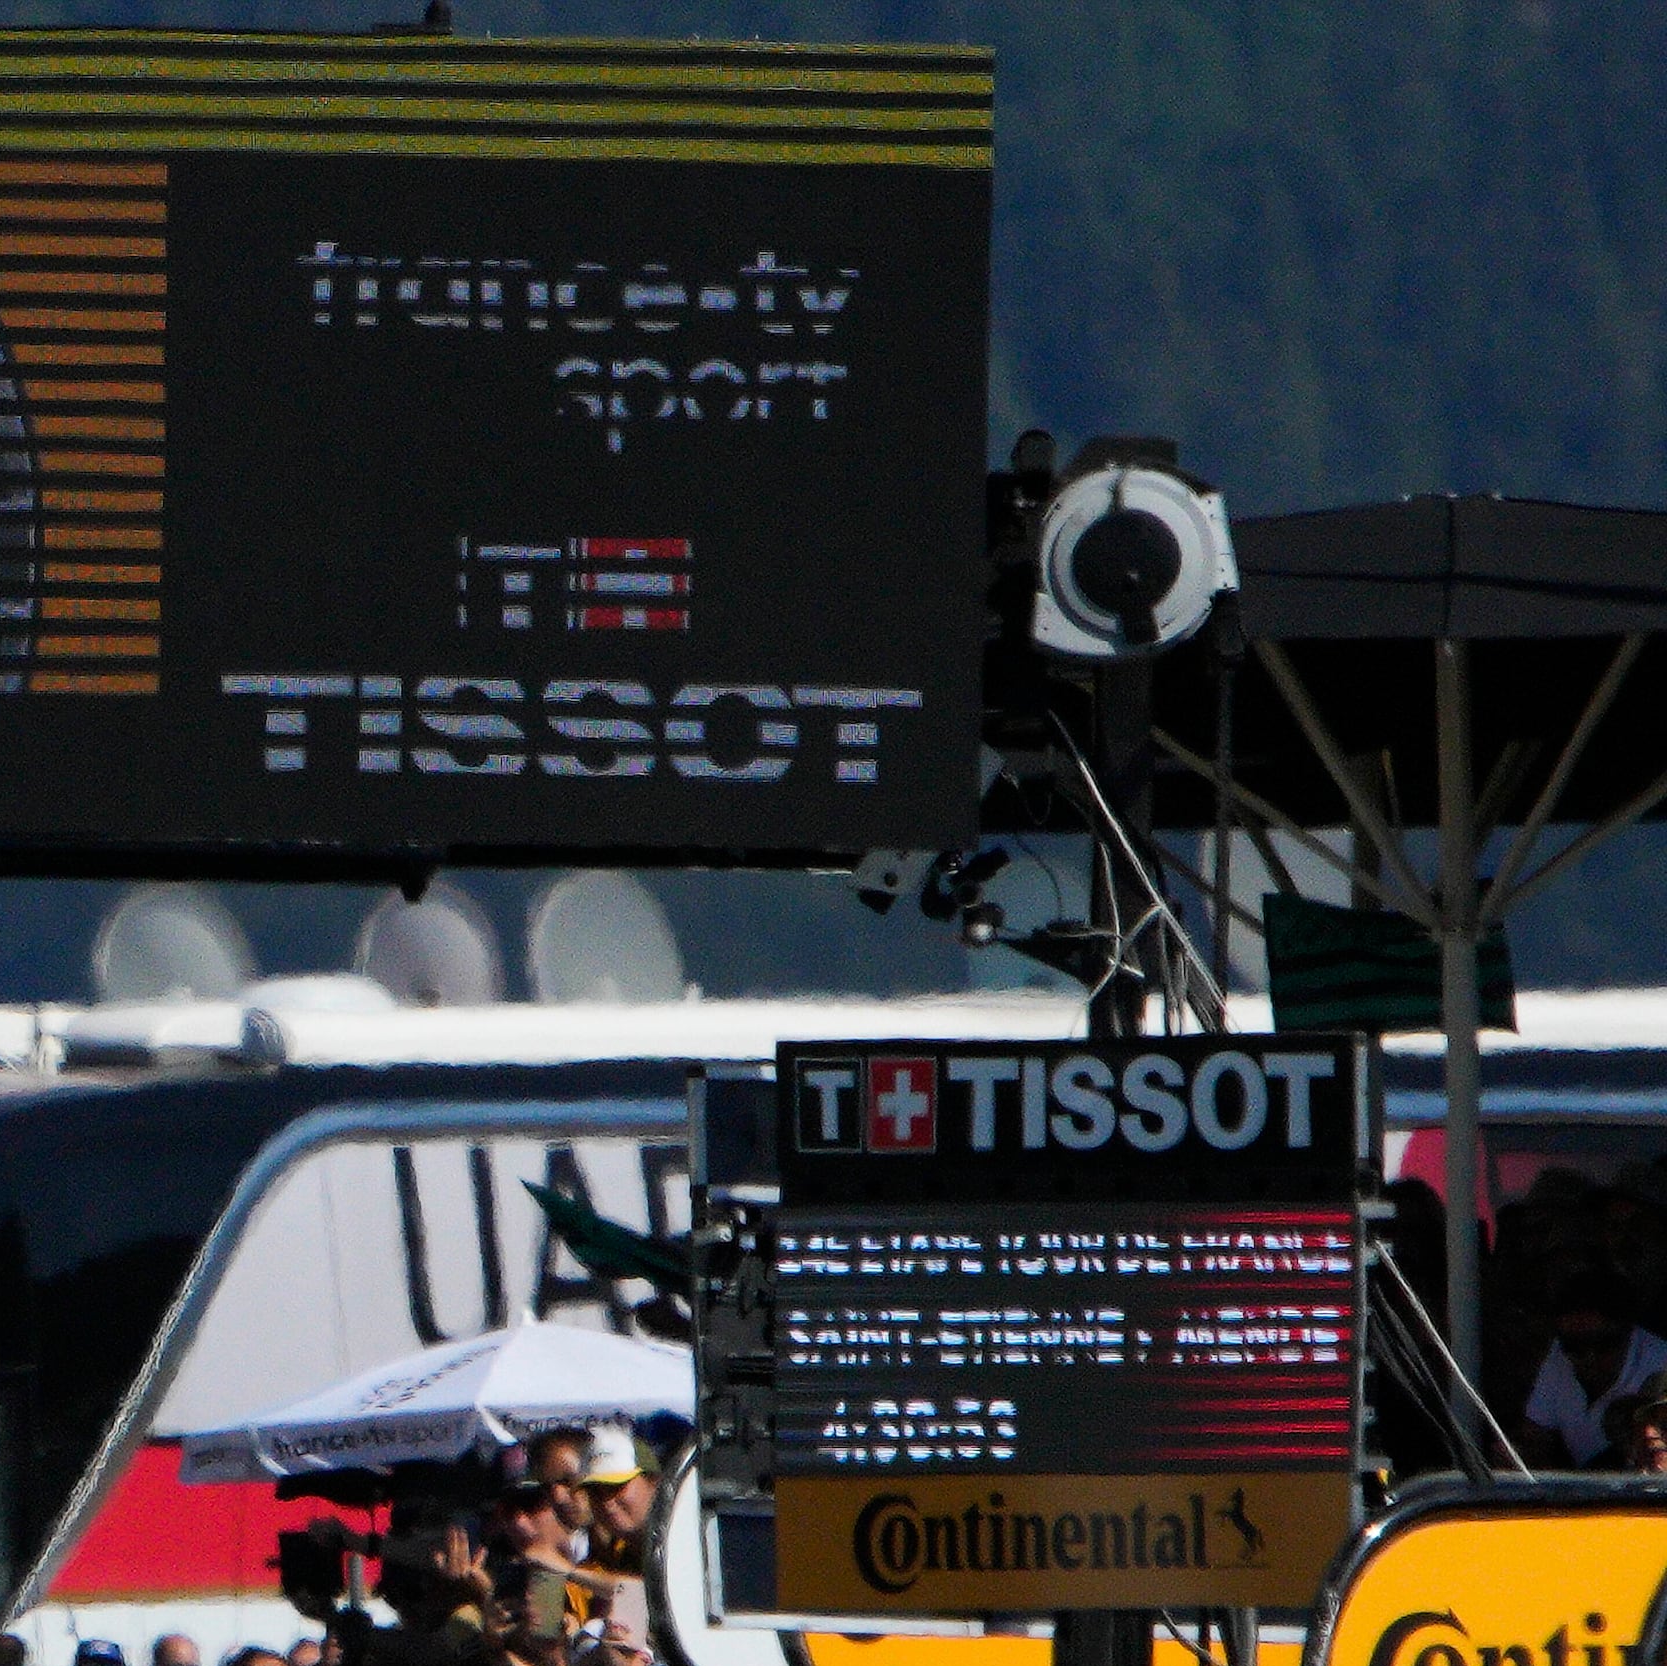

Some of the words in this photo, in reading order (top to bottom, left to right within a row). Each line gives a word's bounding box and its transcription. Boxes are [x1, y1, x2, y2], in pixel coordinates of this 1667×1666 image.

[221, 674, 924, 782] TISSOT
[946, 1051, 1336, 1153] TISSOT
[853, 1489, 1208, 1594] Continental
